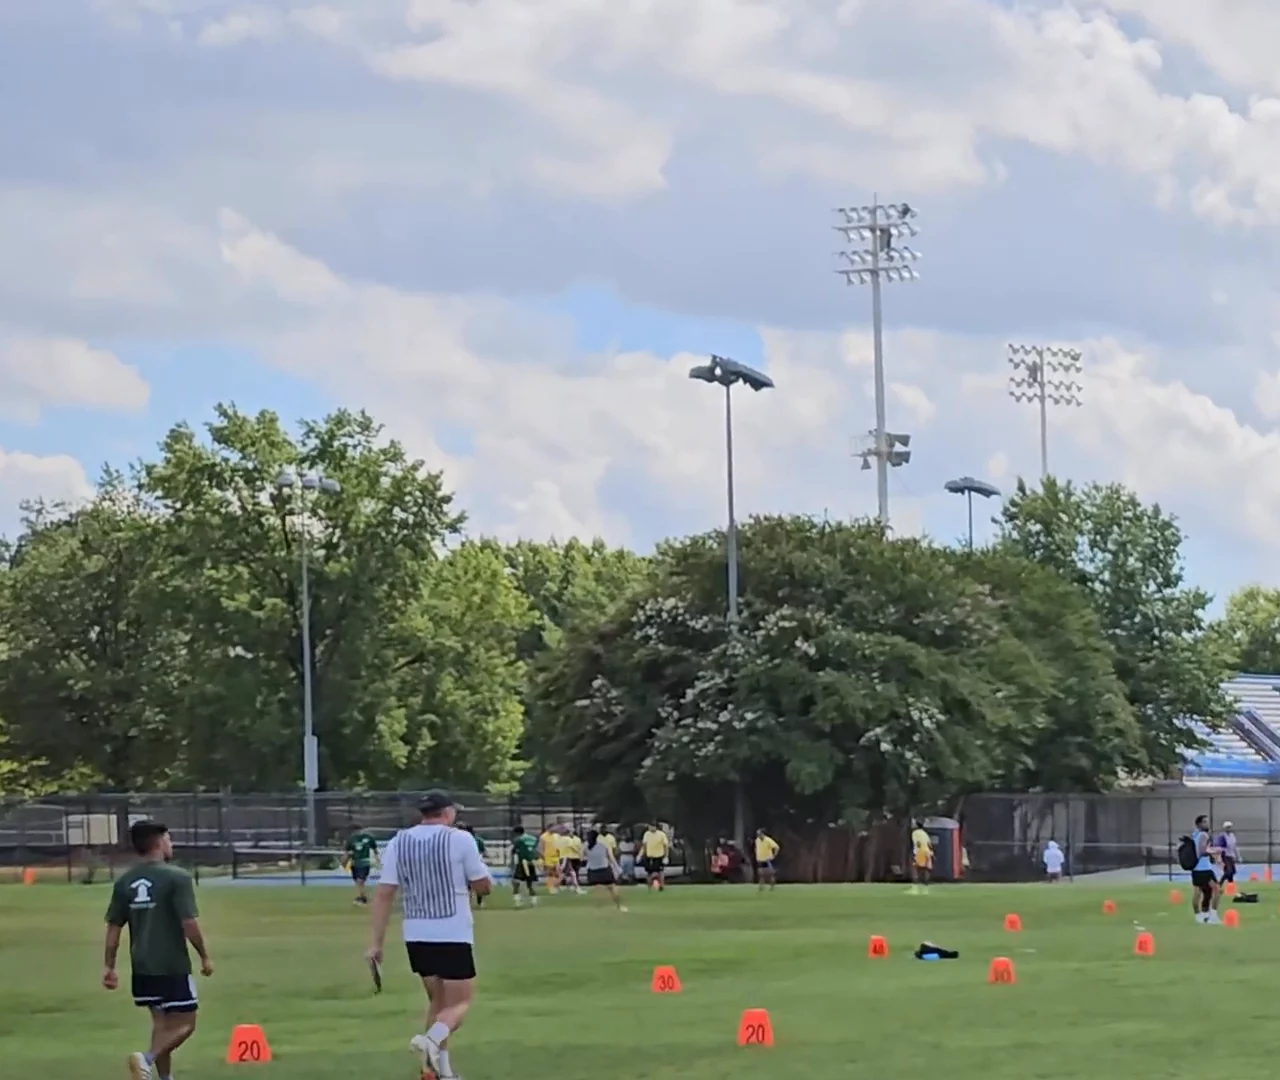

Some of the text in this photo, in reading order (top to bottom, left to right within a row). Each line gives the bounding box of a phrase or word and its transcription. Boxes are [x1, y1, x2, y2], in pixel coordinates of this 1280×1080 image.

[659, 975, 674, 991] 30
[746, 1023, 765, 1044] 20
[238, 1040, 260, 1062] 20
